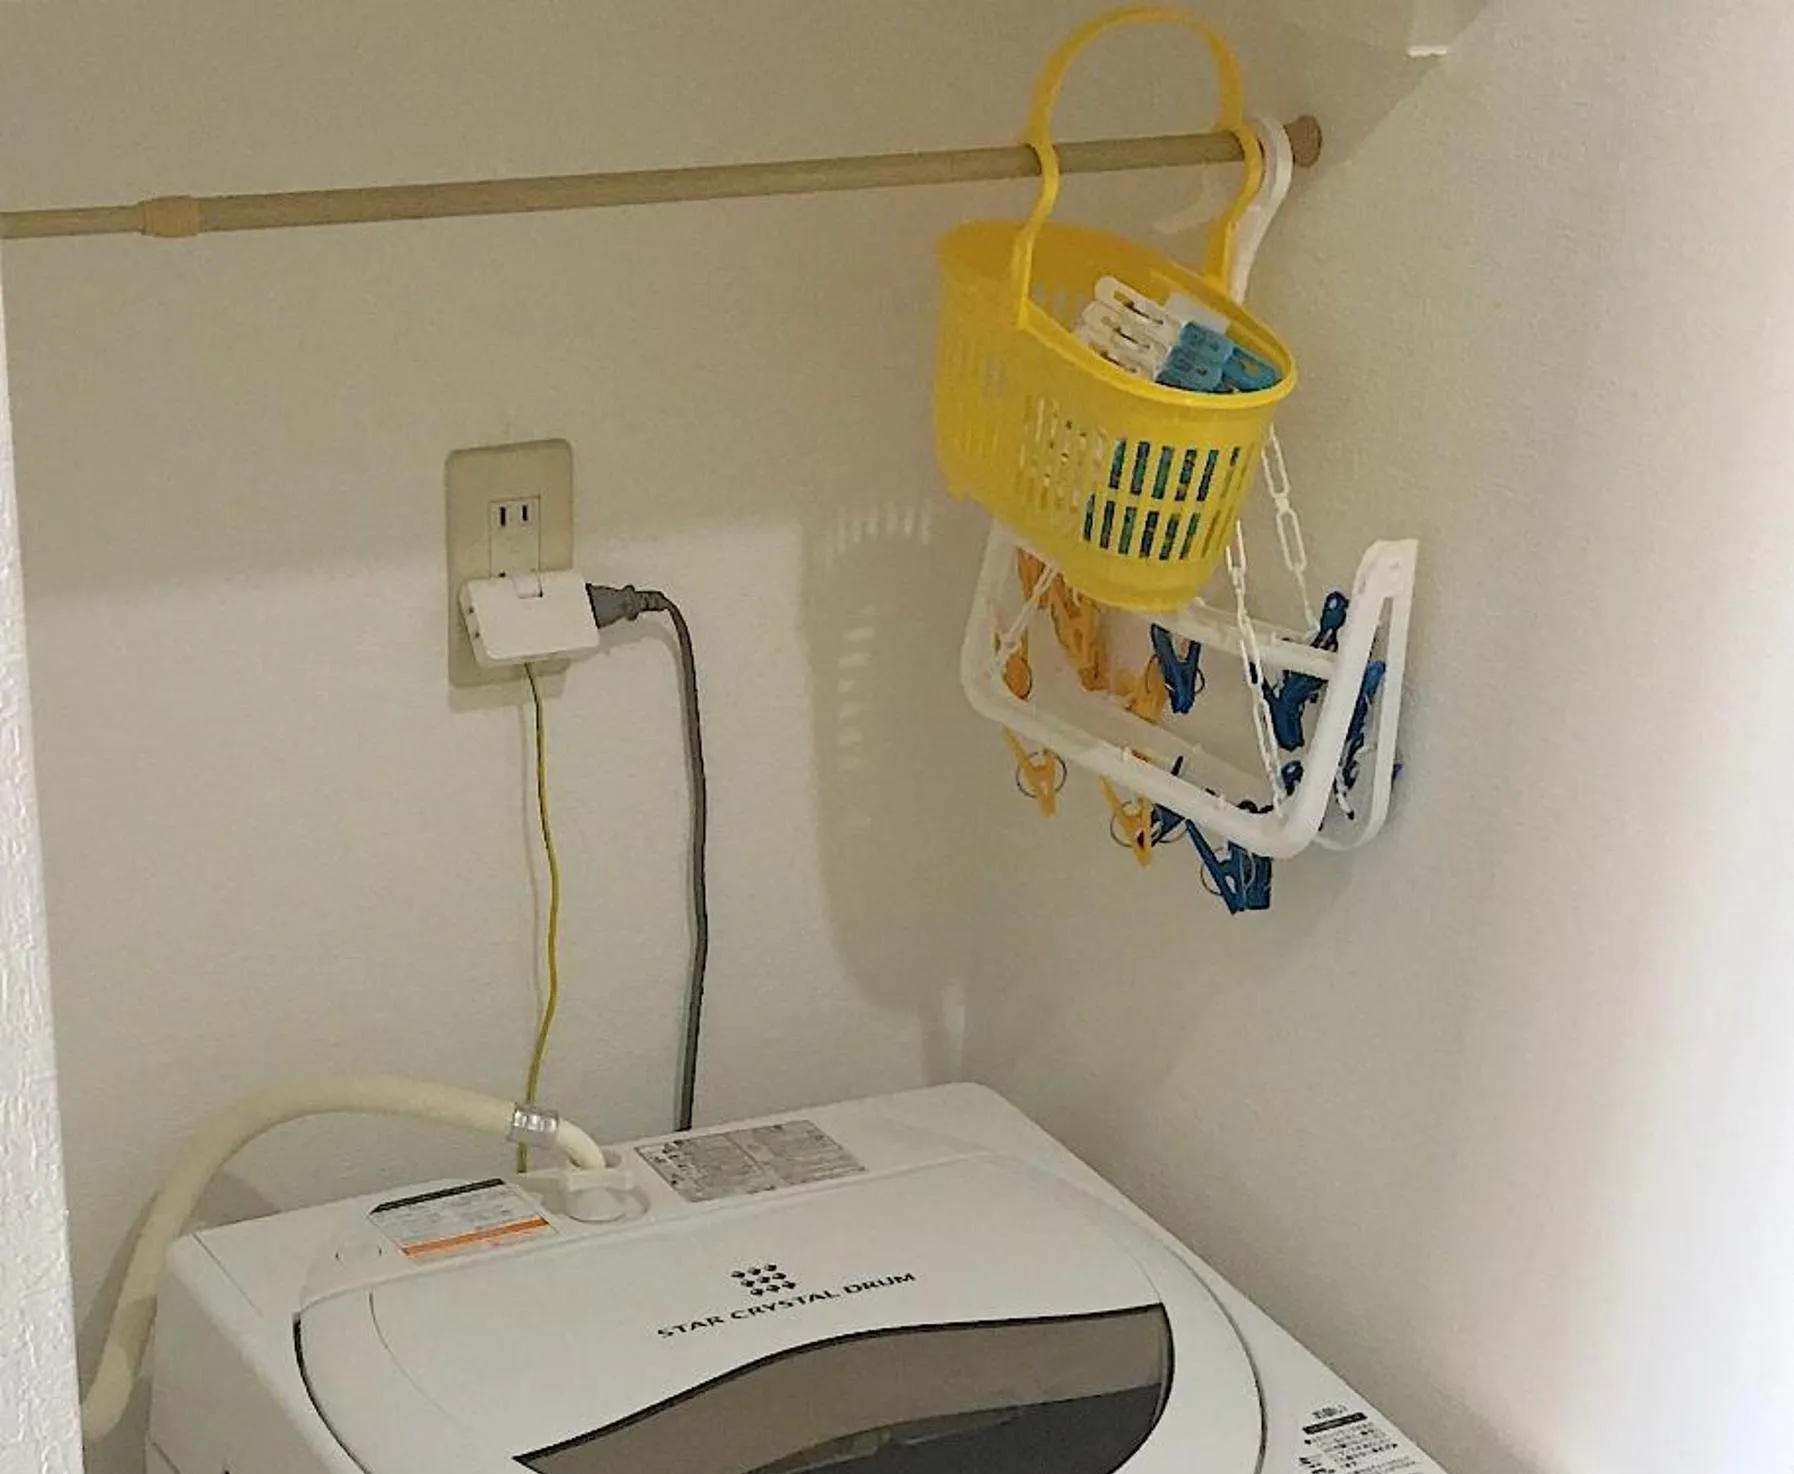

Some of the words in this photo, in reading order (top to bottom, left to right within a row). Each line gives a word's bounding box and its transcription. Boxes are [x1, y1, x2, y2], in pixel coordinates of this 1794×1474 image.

[657, 1315, 725, 1338] STAR
[730, 1290, 840, 1320] CRYSTAL
[843, 1272, 916, 1295] DRUM
